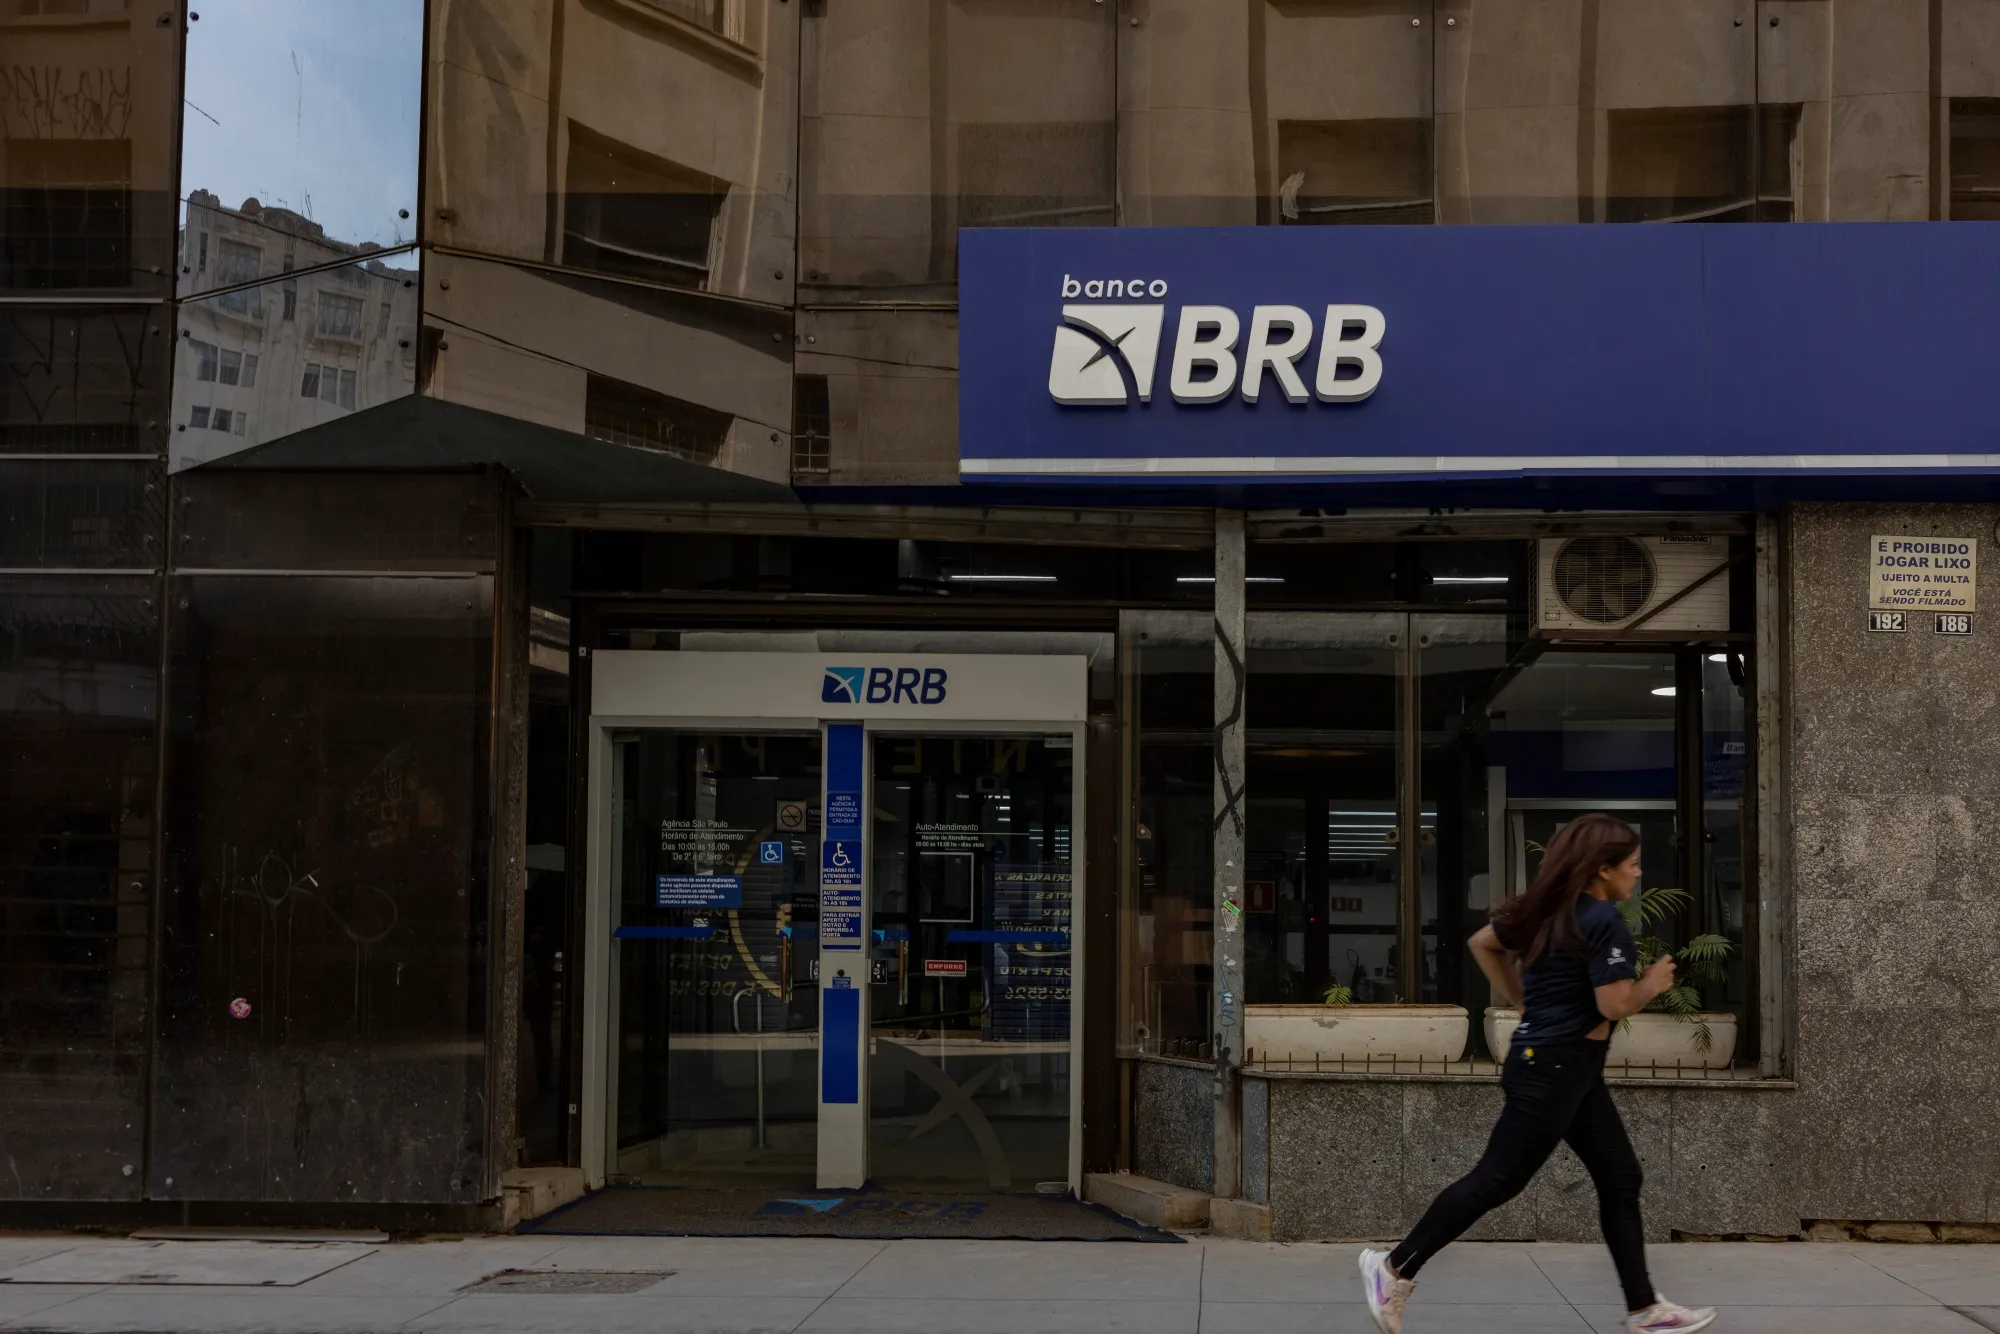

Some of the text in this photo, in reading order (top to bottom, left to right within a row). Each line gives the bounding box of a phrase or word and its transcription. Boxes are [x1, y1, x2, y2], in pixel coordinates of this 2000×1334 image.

[1062, 274, 1168, 299] banco
[1170, 304, 1386, 404] BRB
[1878, 539, 1969, 555] É PROIBIDO
[1876, 555, 1971, 569] JOGAR LIXO
[1923, 574, 1931, 583] A
[1934, 574, 1970, 584] MULTA
[1892, 587, 1951, 597] VOCÊ ESTÁ
[1878, 596, 1966, 606] SENDO FILMADO
[1874, 613, 1902, 630] 192
[1940, 616, 1968, 632] 186
[866, 667, 948, 704] BRB
[661, 819, 728, 830] Agência São Paulo
[915, 822, 979, 832] Auto-Atendimento
[661, 831, 744, 841] Horário de Atendimento
[661, 842, 676, 851] Das
[677, 842, 696, 851] 10:00
